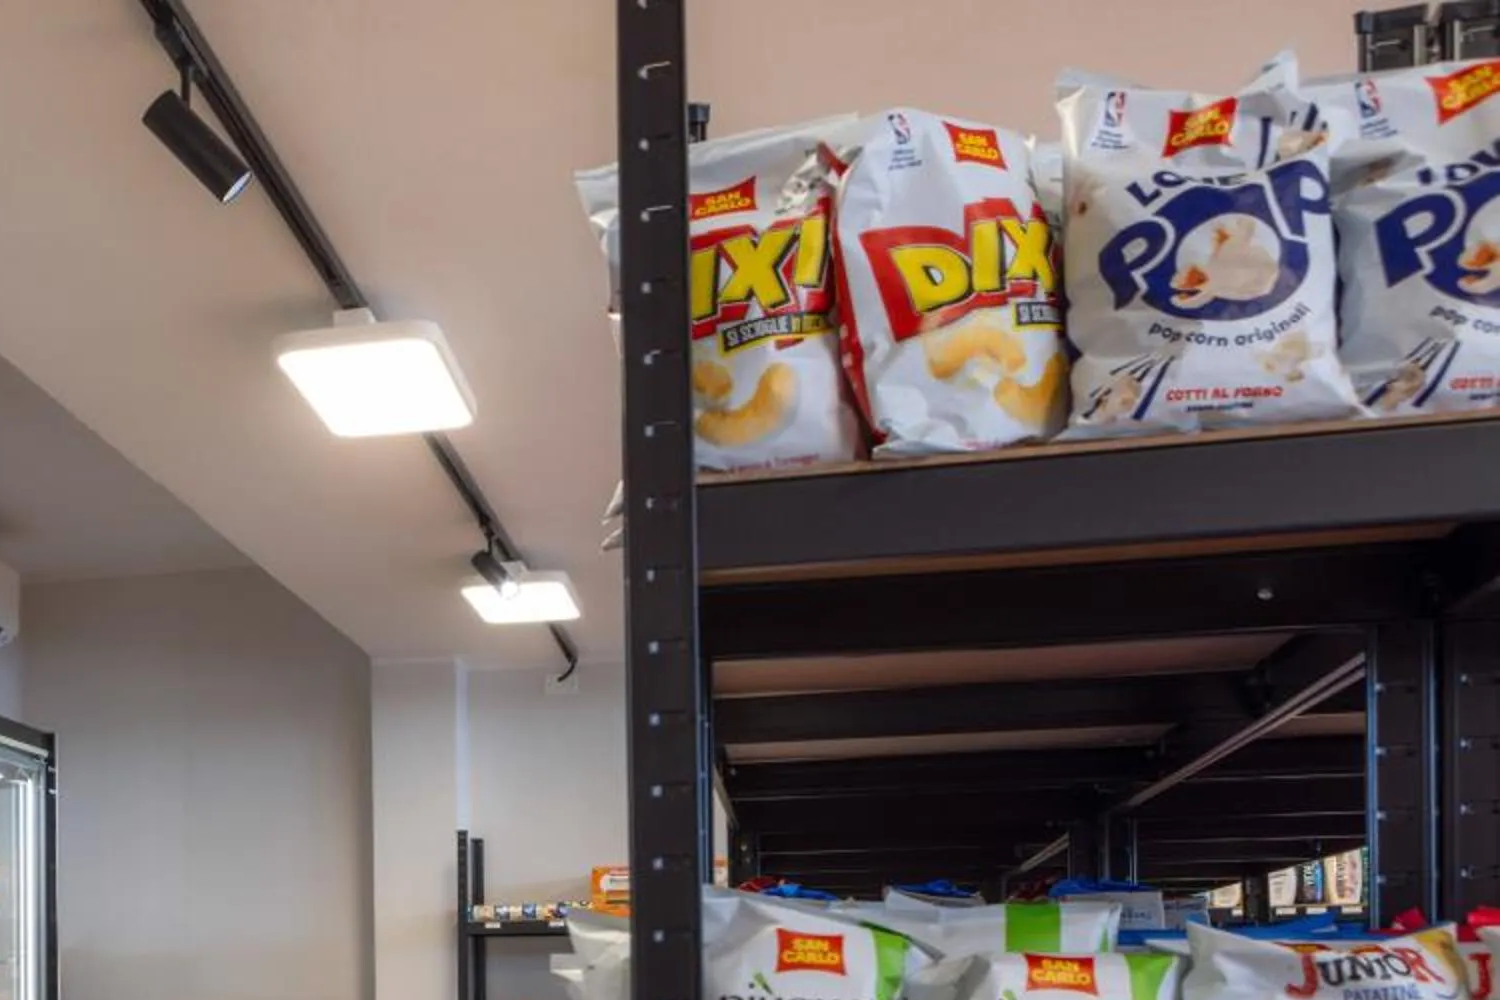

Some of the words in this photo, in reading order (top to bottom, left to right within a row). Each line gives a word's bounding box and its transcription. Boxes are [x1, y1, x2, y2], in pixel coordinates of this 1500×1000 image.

[1097, 159, 1331, 321] POP
[691, 216, 827, 320] IXI
[887, 216, 1055, 313] DIX
[1149, 322, 1182, 344] pop
[1185, 330, 1229, 348] corn
[782, 950, 840, 965] CARLO
[792, 938, 830, 951] SAN
[1030, 969, 1093, 986] CARLO
[1041, 958, 1081, 972] SAN
[1273, 941, 1446, 999] JUNIOR
